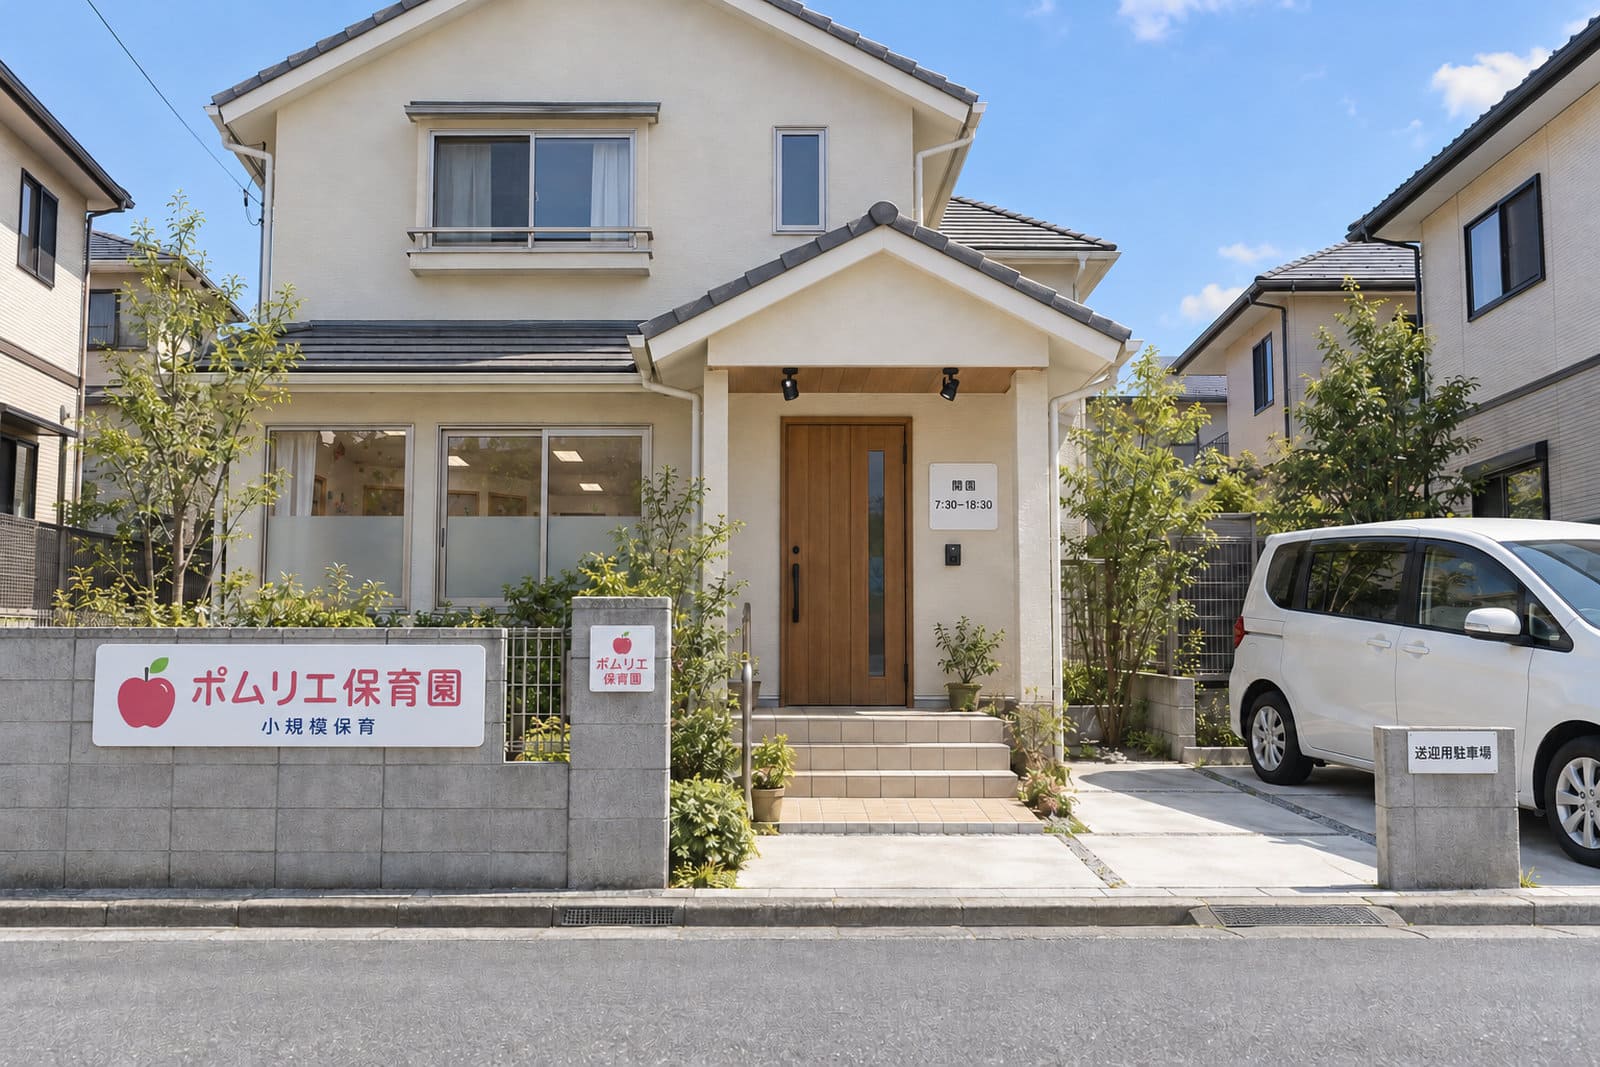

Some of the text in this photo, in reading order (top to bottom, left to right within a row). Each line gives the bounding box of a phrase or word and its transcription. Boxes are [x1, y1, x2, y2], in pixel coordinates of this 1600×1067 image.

[596, 657, 648, 671] ポムリエ
[191, 665, 462, 708] ポムリエ保育園
[603, 672, 642, 686] 保育園
[261, 716, 376, 736] 小規模保育
[1414, 745, 1492, 761] 送迎用駐車場
